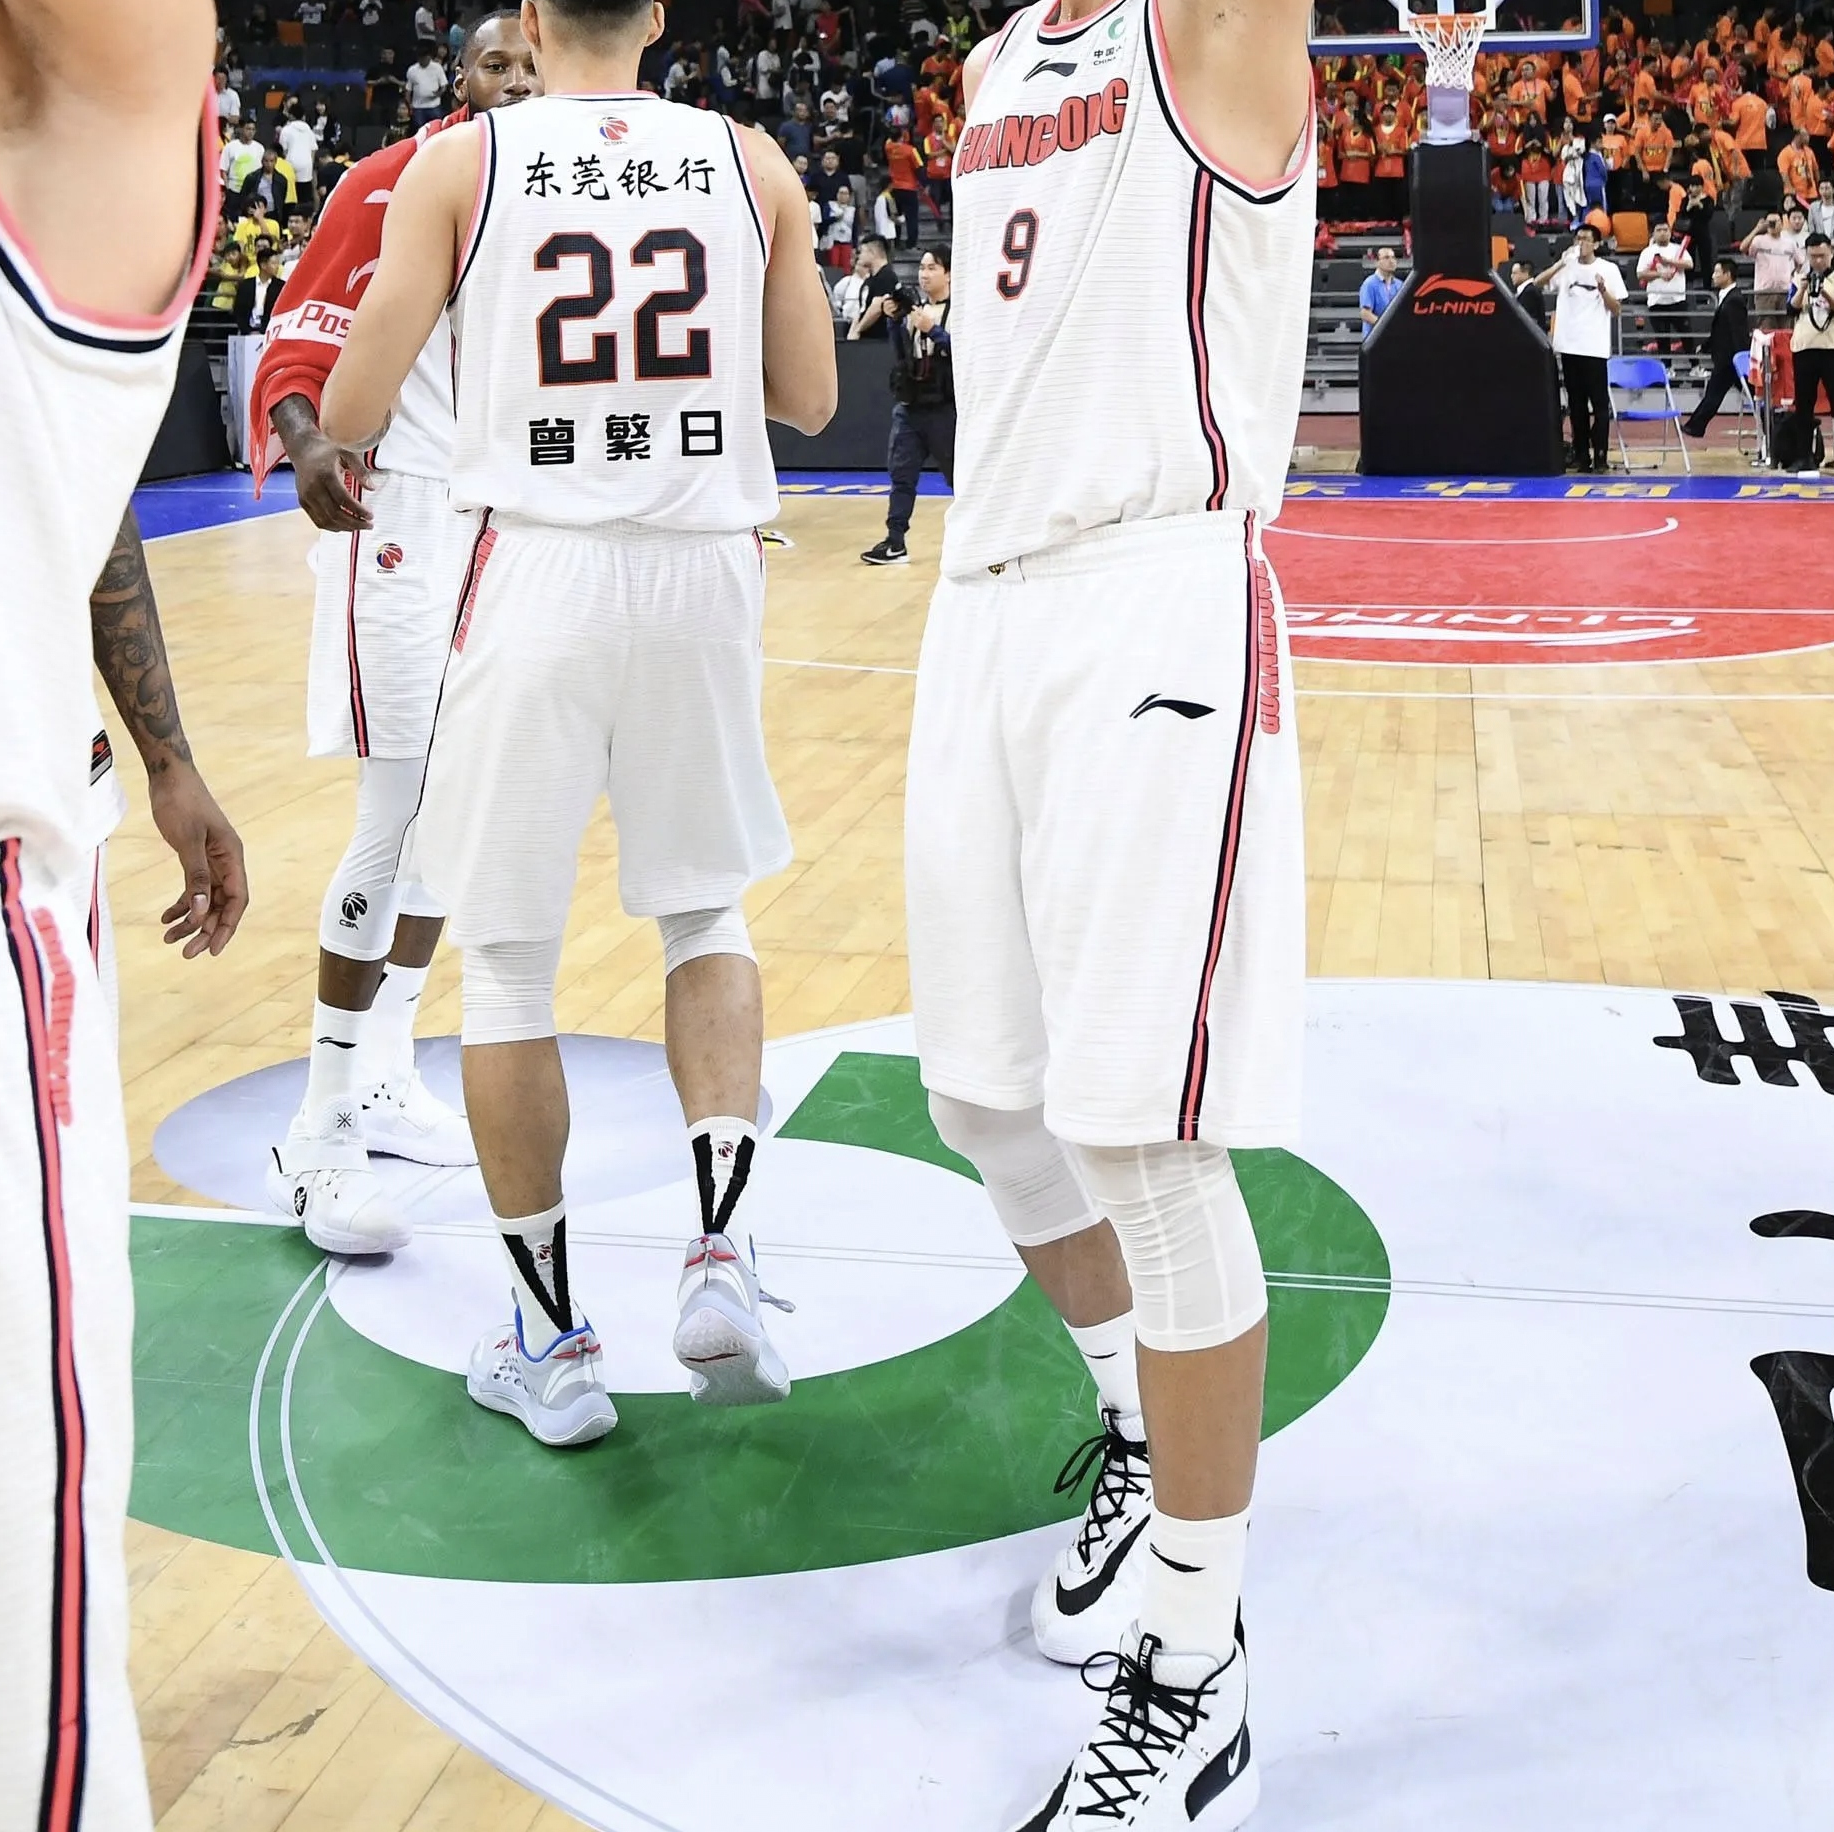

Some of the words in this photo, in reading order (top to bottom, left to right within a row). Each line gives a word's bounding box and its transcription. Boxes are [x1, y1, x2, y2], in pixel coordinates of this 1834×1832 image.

[523, 150, 716, 201] 东莞银行
[996, 207, 1040, 302] 9
[535, 228, 712, 389] 22
[1413, 301, 1496, 315] LI-NING
[528, 410, 723, 467] 曾繁日
